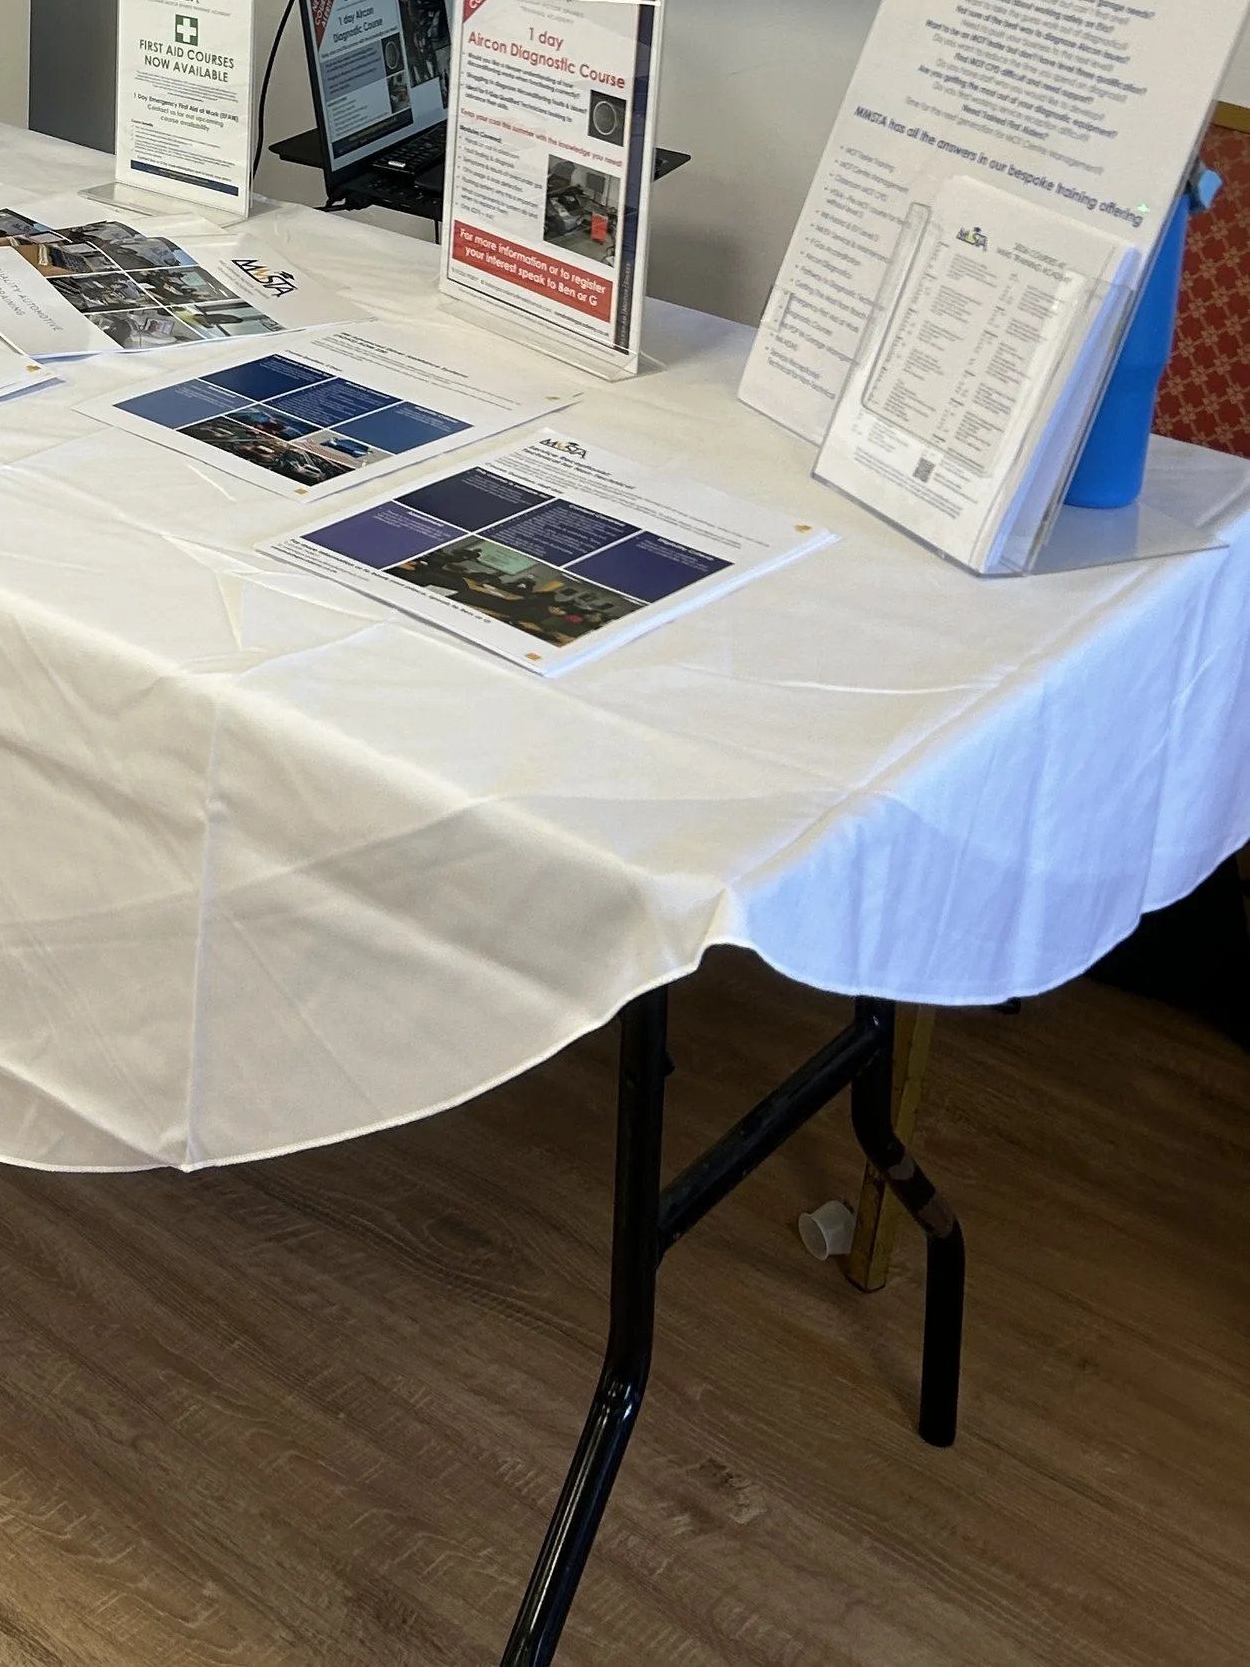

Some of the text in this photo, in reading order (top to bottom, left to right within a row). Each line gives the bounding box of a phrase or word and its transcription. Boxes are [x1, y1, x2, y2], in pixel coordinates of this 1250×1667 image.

[139, 38, 234, 69] FIRST AID COURSES
[529, 27, 563, 51] 1 day
[144, 54, 228, 82] NOW AVAILABLE
[468, 31, 625, 88] Aircon Diagnostic Course
[459, 227, 605, 293] For more information or to register
[465, 246, 597, 305] your interest speak to Ben or G
[18, 292, 62, 332] AUTOMOTIVE
